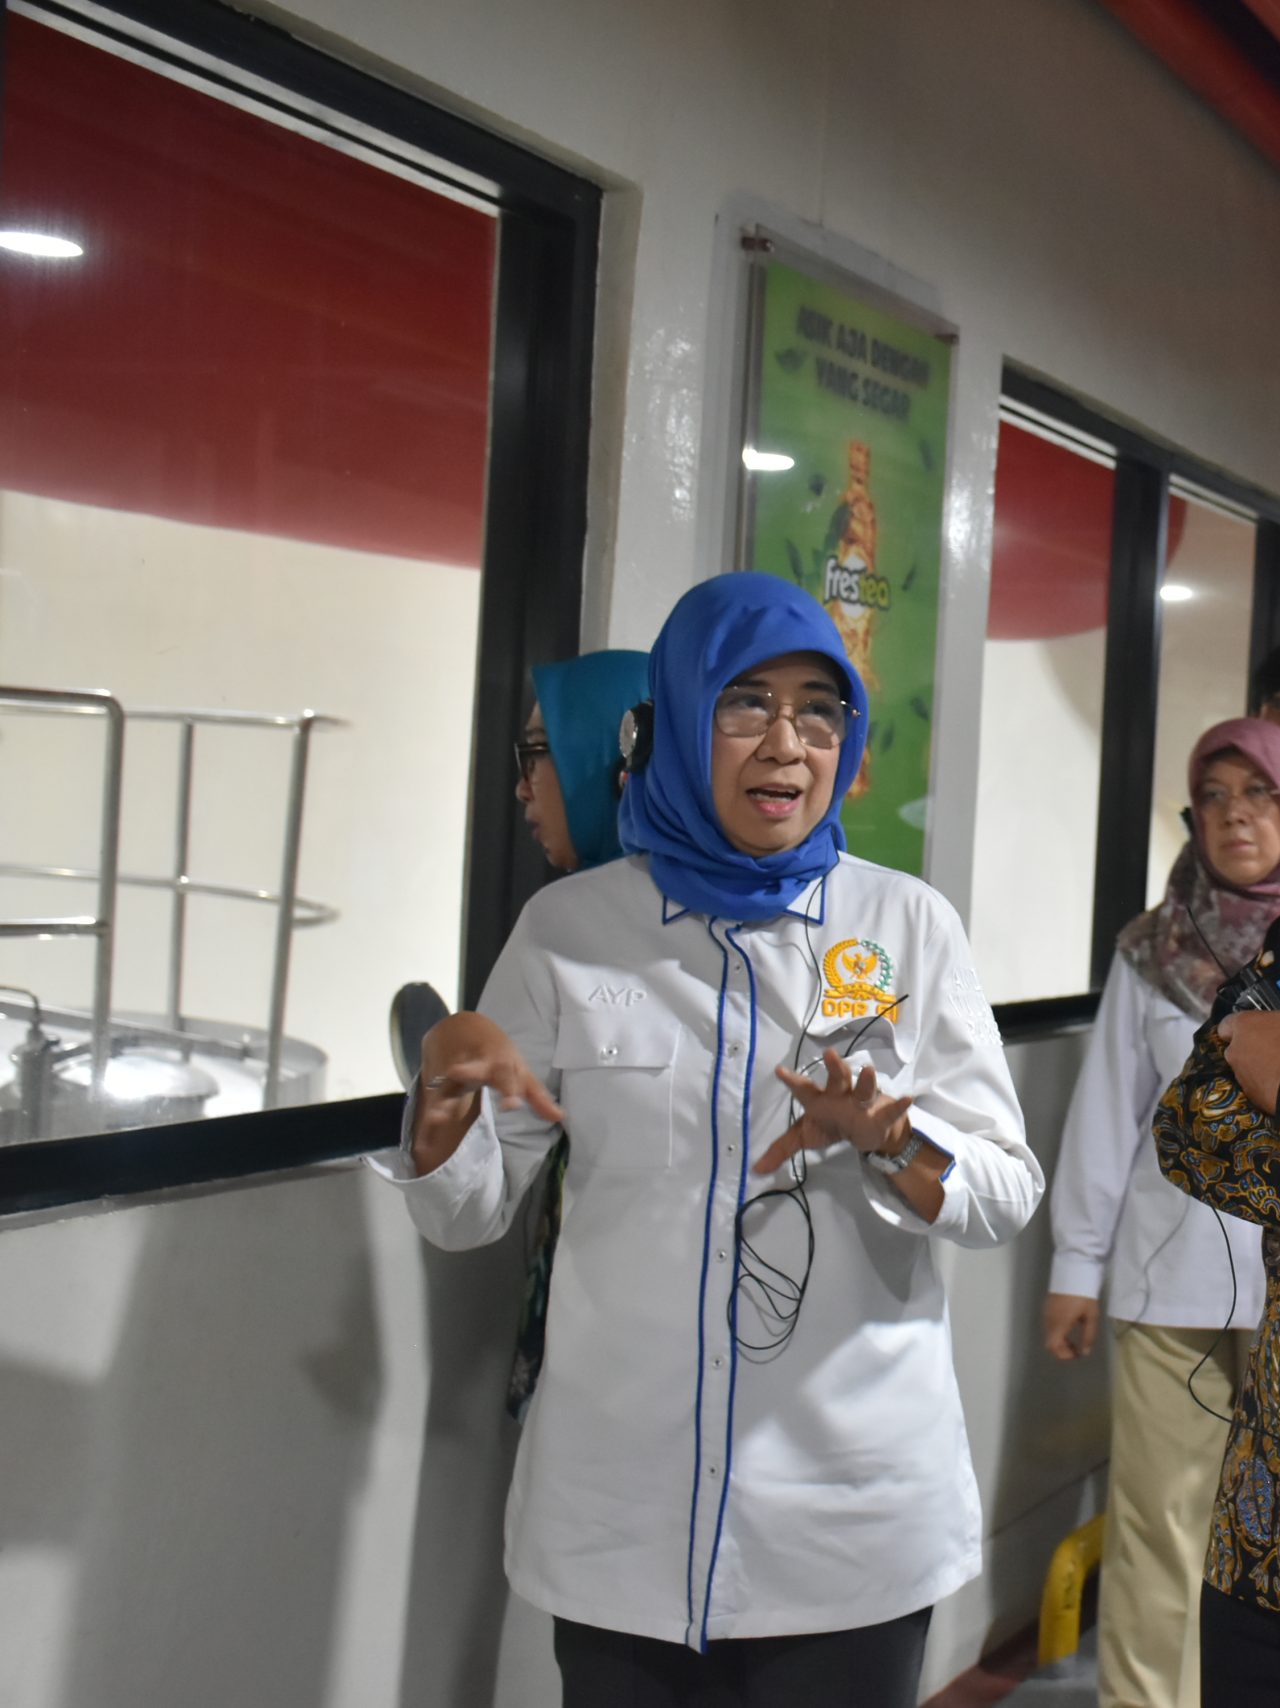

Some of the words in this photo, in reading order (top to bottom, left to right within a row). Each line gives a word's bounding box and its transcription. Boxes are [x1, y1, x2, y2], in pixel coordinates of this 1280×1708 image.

[836, 322, 867, 363] AJA
[870, 337, 930, 391] DENGAN
[815, 356, 860, 403] YANG
[861, 376, 911, 424] SEGAR
[824, 555, 890, 609] frestea
[588, 983, 648, 1007] AYP
[821, 998, 867, 1019] DPR
